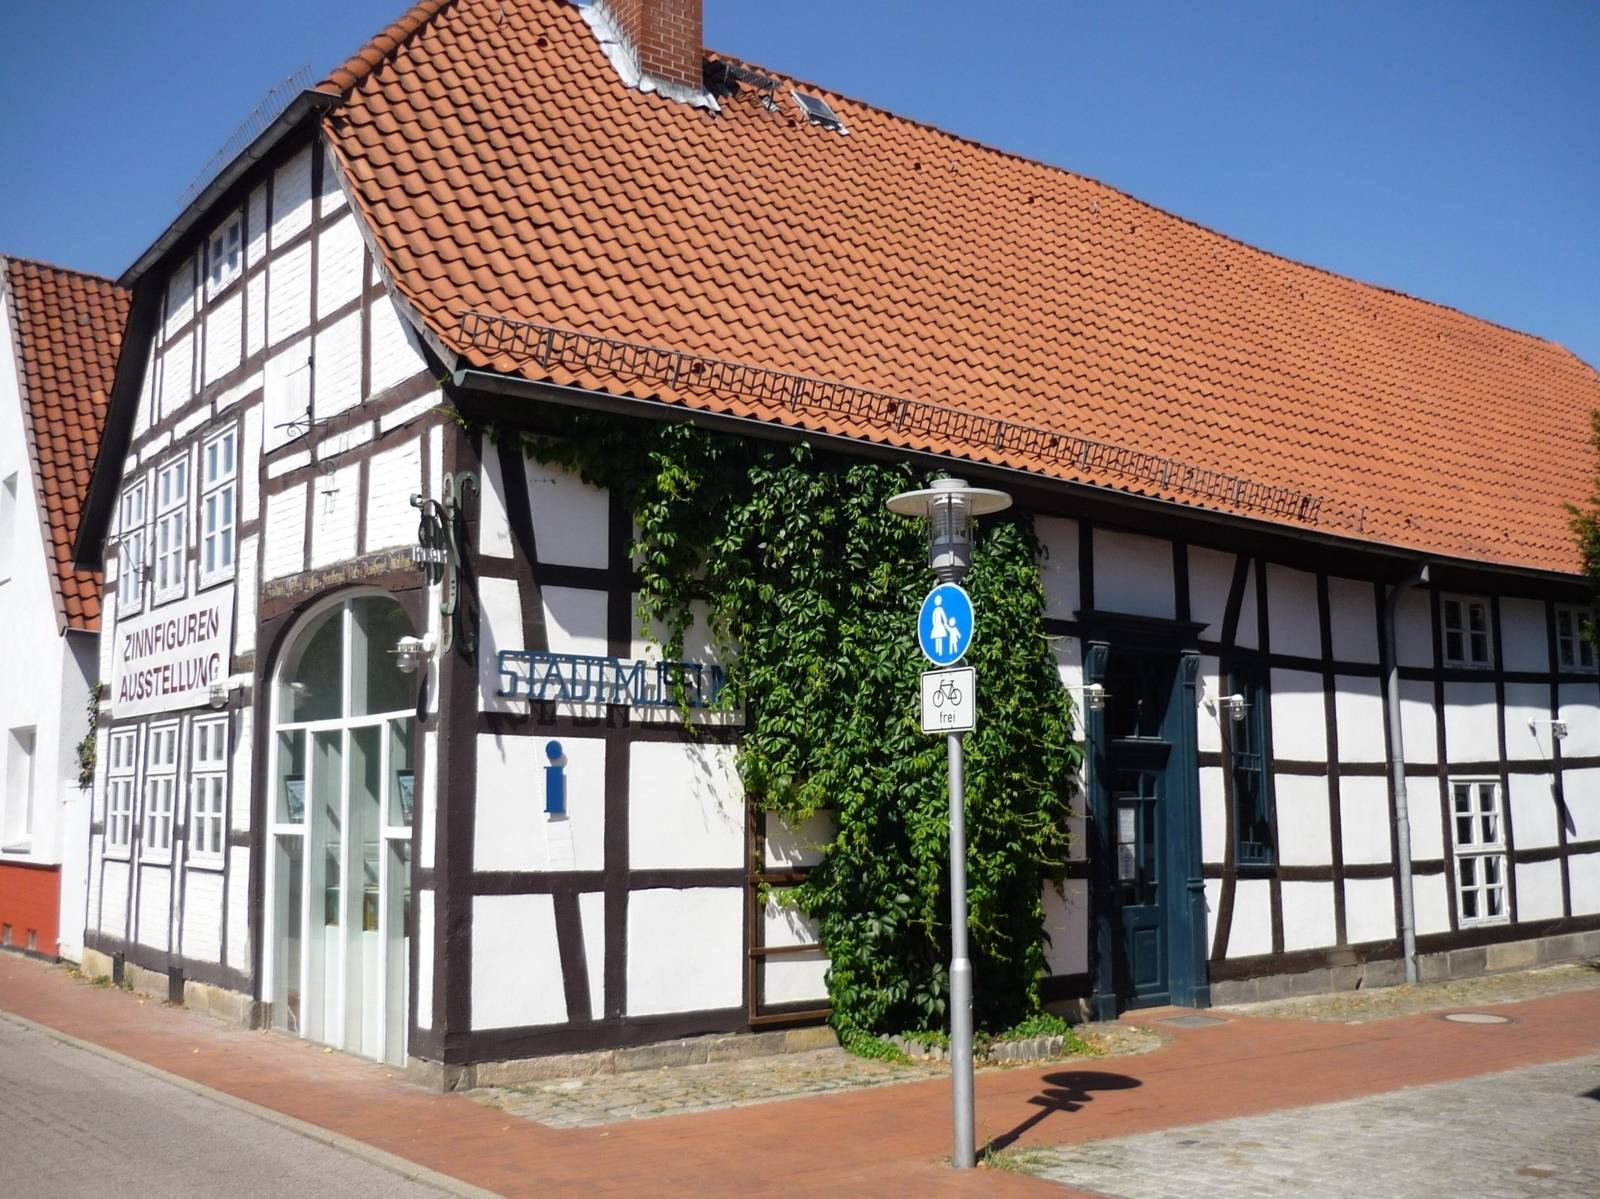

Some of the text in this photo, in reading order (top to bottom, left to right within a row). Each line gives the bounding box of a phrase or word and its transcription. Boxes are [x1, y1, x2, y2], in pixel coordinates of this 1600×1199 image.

[123, 605, 220, 663] ZINNFIGUREN
[118, 652, 221, 704] AUSSTELLUNG
[939, 710, 956, 724] frei
